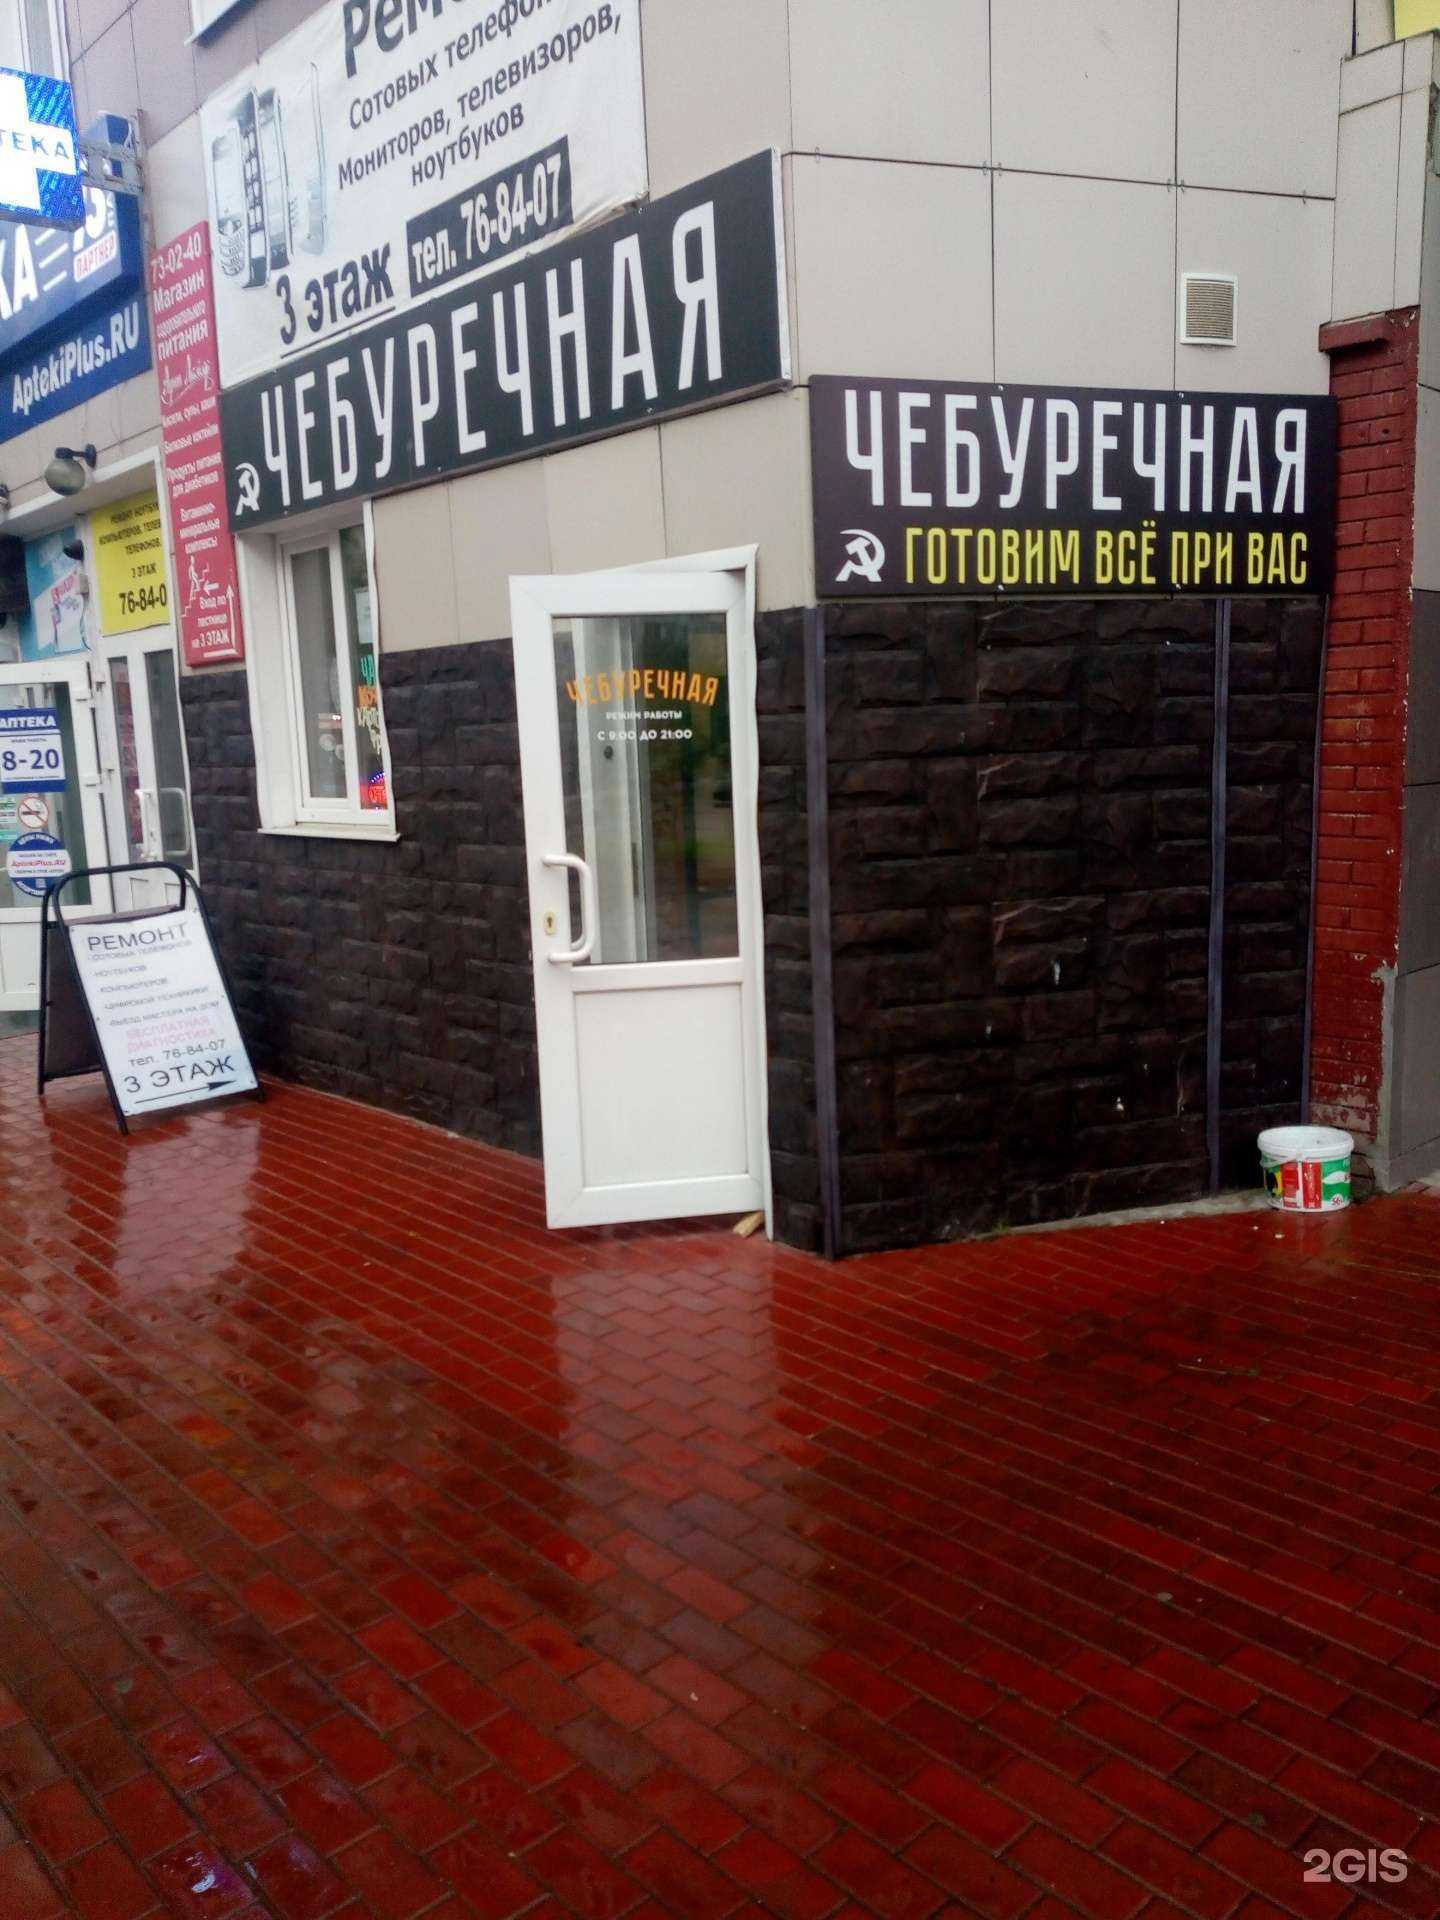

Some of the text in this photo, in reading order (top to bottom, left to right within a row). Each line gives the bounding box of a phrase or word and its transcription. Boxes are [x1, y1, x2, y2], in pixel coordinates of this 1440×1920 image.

[338, 2, 621, 190] Мониторов, телевизоров,
[350, 54, 438, 130] Сотовых
[411, 102, 524, 187] ноутбуков
[412, 152, 561, 274] тел. 76-84-07
[151, 231, 202, 284] 73-02-40
[153, 268, 205, 313] Магазин
[276, 241, 394, 345] 3 этаж
[12, 301, 140, 416] AptekiPlus.RU
[158, 319, 209, 361] питания
[261, 200, 723, 507] ЧЕБУРЕЧНАЯ
[844, 389, 1308, 514] ЧЕБУРЕЧНАЯ
[905, 520, 1308, 584] ГОТОВИМ ВСЁ ПРИ ВАС
[566, 669, 719, 706] ЧЕБУРЕЧНАЯ
[606, 710, 683, 720] РЕЖИМ РАБОТЫ
[597, 730, 605, 741] С
[640, 730, 657, 741] ДО
[87, 922, 188, 951] РЕМОНТ
[124, 1055, 235, 1093] 3 ЭТАЖ
[163, 1039, 225, 1060] 76-84-07
